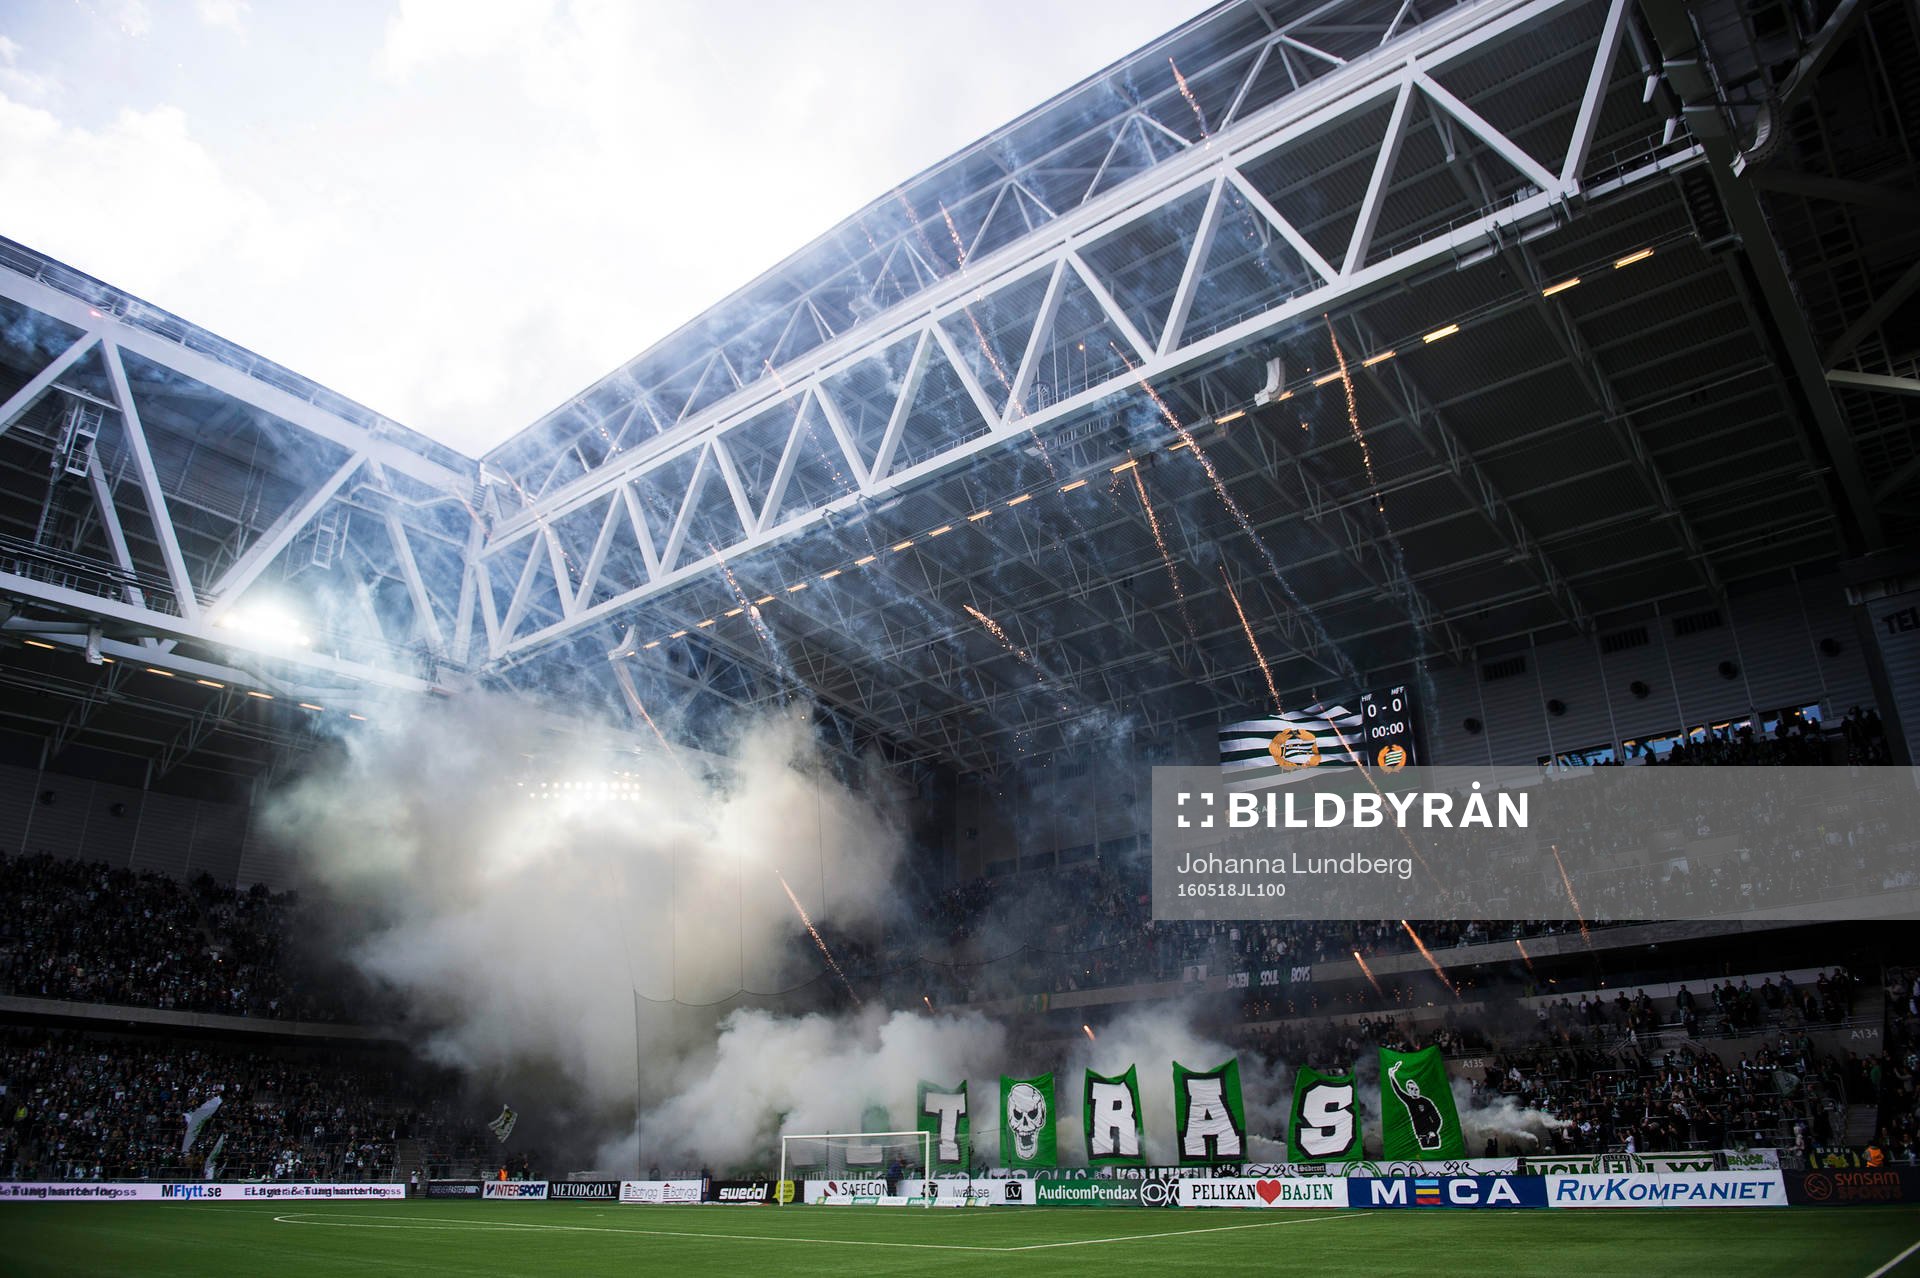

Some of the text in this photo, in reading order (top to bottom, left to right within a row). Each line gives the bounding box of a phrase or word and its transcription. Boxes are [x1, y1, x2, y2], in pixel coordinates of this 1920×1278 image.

[1367, 704, 1377, 718] 0
[1392, 698, 1402, 712] 0
[1372, 721, 1404, 739] 00:00
[1260, 969, 1279, 986] SOUL
[1291, 966, 1311, 983] BOYS
[162, 1184, 221, 1200] MFlytt.se
[494, 1184, 546, 1197] INTERSPORT
[719, 1183, 768, 1200] swedol
[1038, 1184, 1137, 1200] AudicomPendax
[1192, 1184, 1333, 1200] PELIKAN BAJEN
